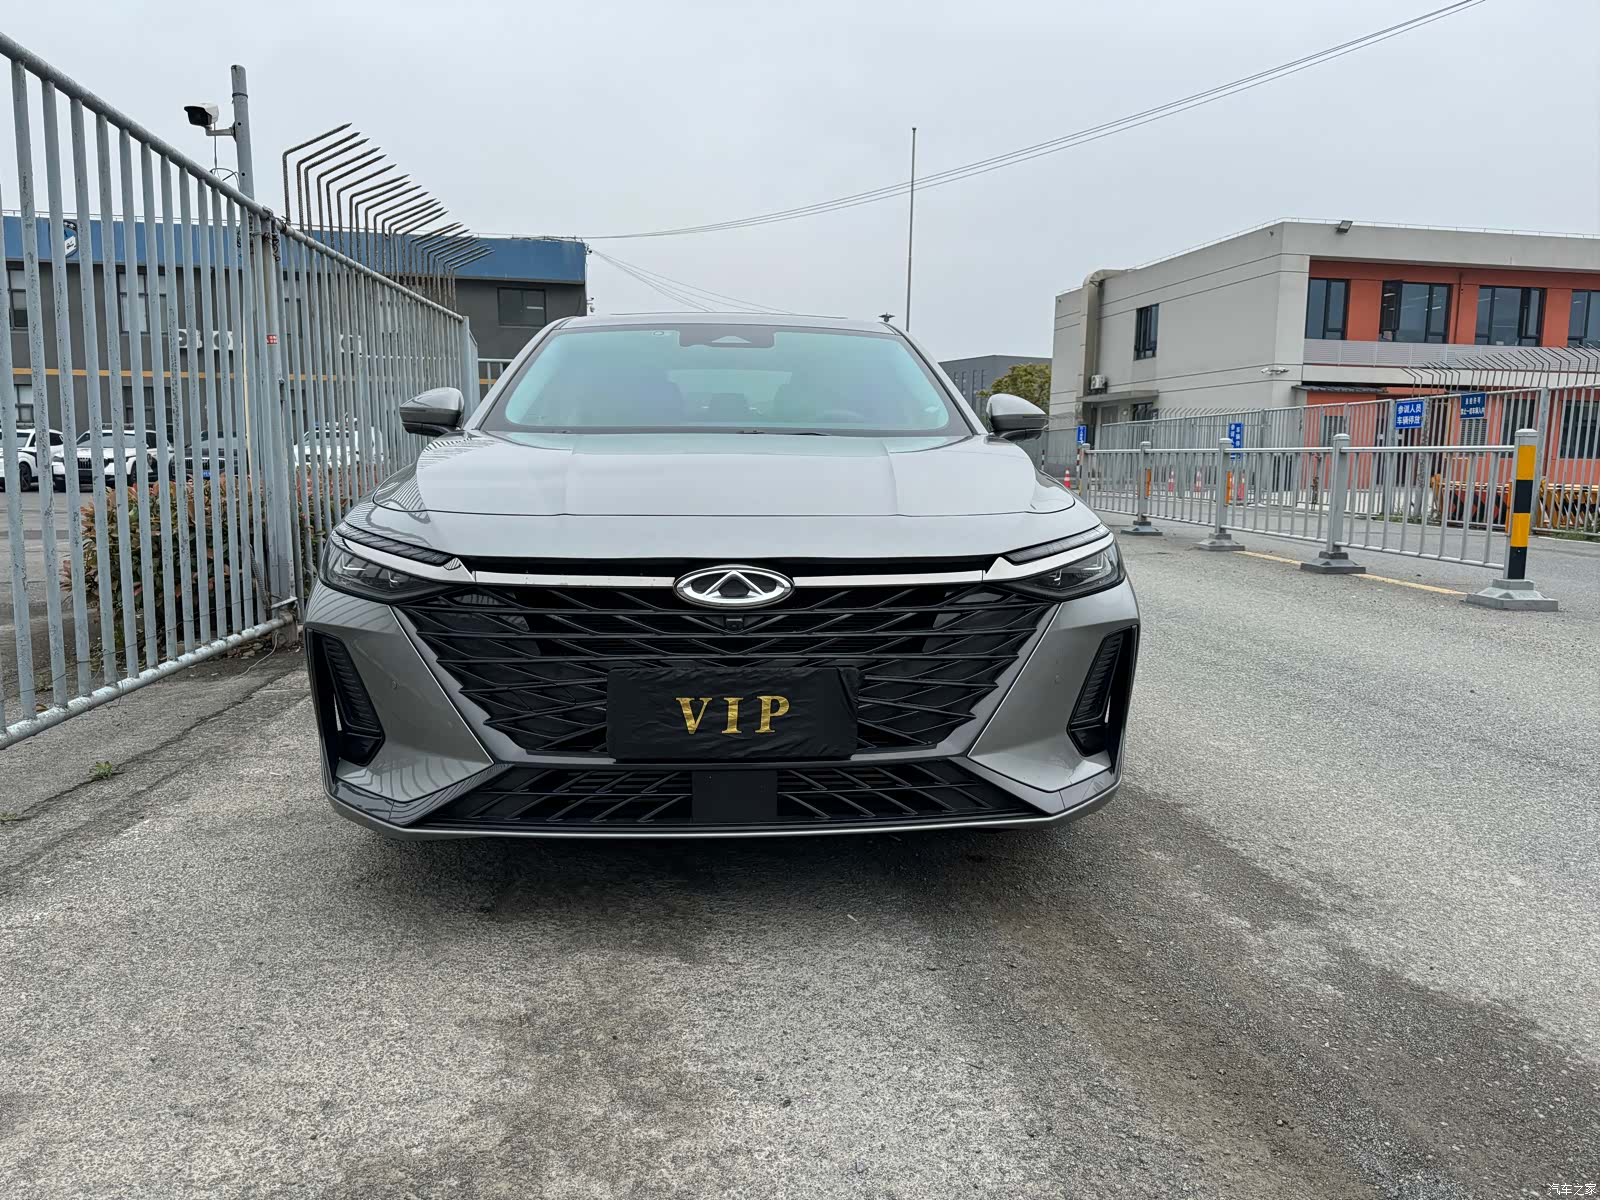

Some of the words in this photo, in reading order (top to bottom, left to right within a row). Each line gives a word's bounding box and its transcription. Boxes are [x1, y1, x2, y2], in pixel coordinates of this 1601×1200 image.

[1397, 403, 1422, 415] 参训人员
[1396, 415, 1420, 426] 车辆停放
[676, 695, 790, 735] VIP
